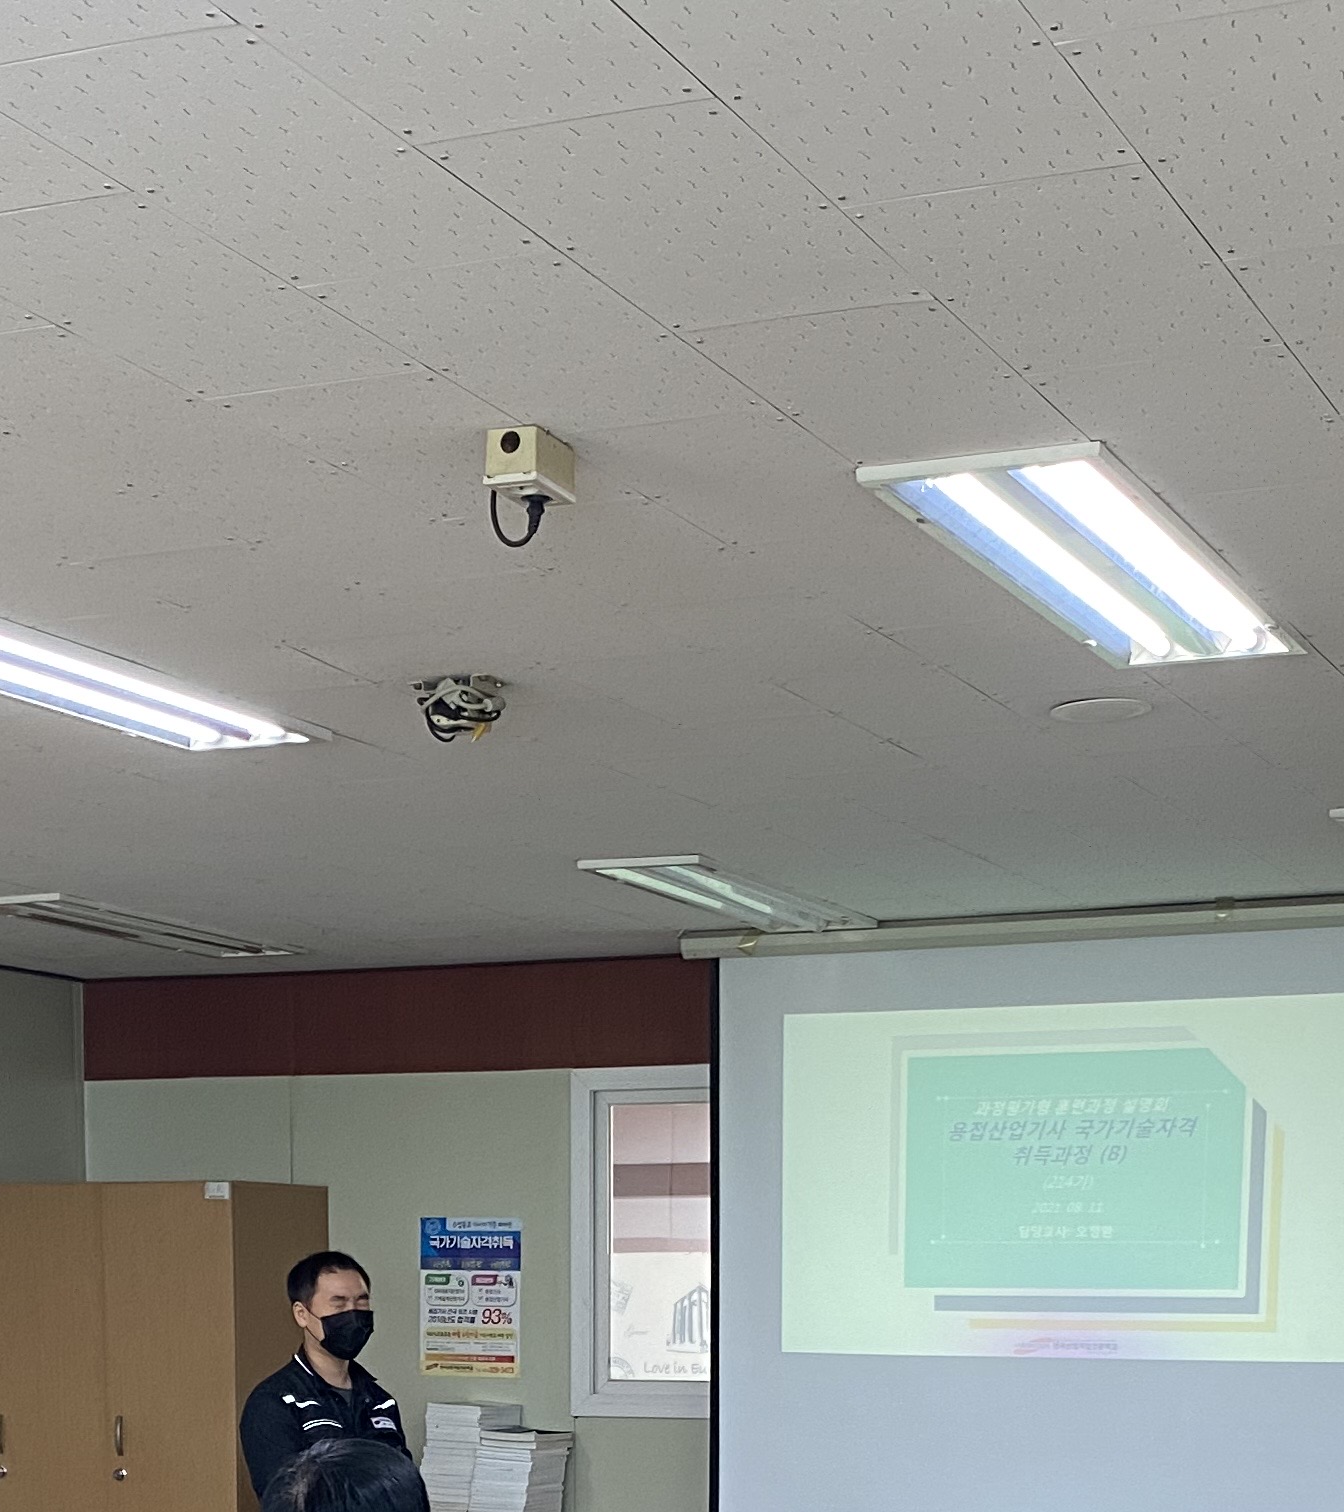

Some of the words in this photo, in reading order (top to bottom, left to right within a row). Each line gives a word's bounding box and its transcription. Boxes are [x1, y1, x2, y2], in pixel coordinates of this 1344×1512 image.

[949, 1120, 1067, 1142] 용접산업기사
[1075, 1116, 1200, 1139] 국가기술자격
[1014, 1145, 1093, 1166] 취득과정
[1100, 1144, 1128, 1165] (B)
[429, 1236, 513, 1249] 국가기술자격취득
[481, 1309, 512, 1324] 93%
